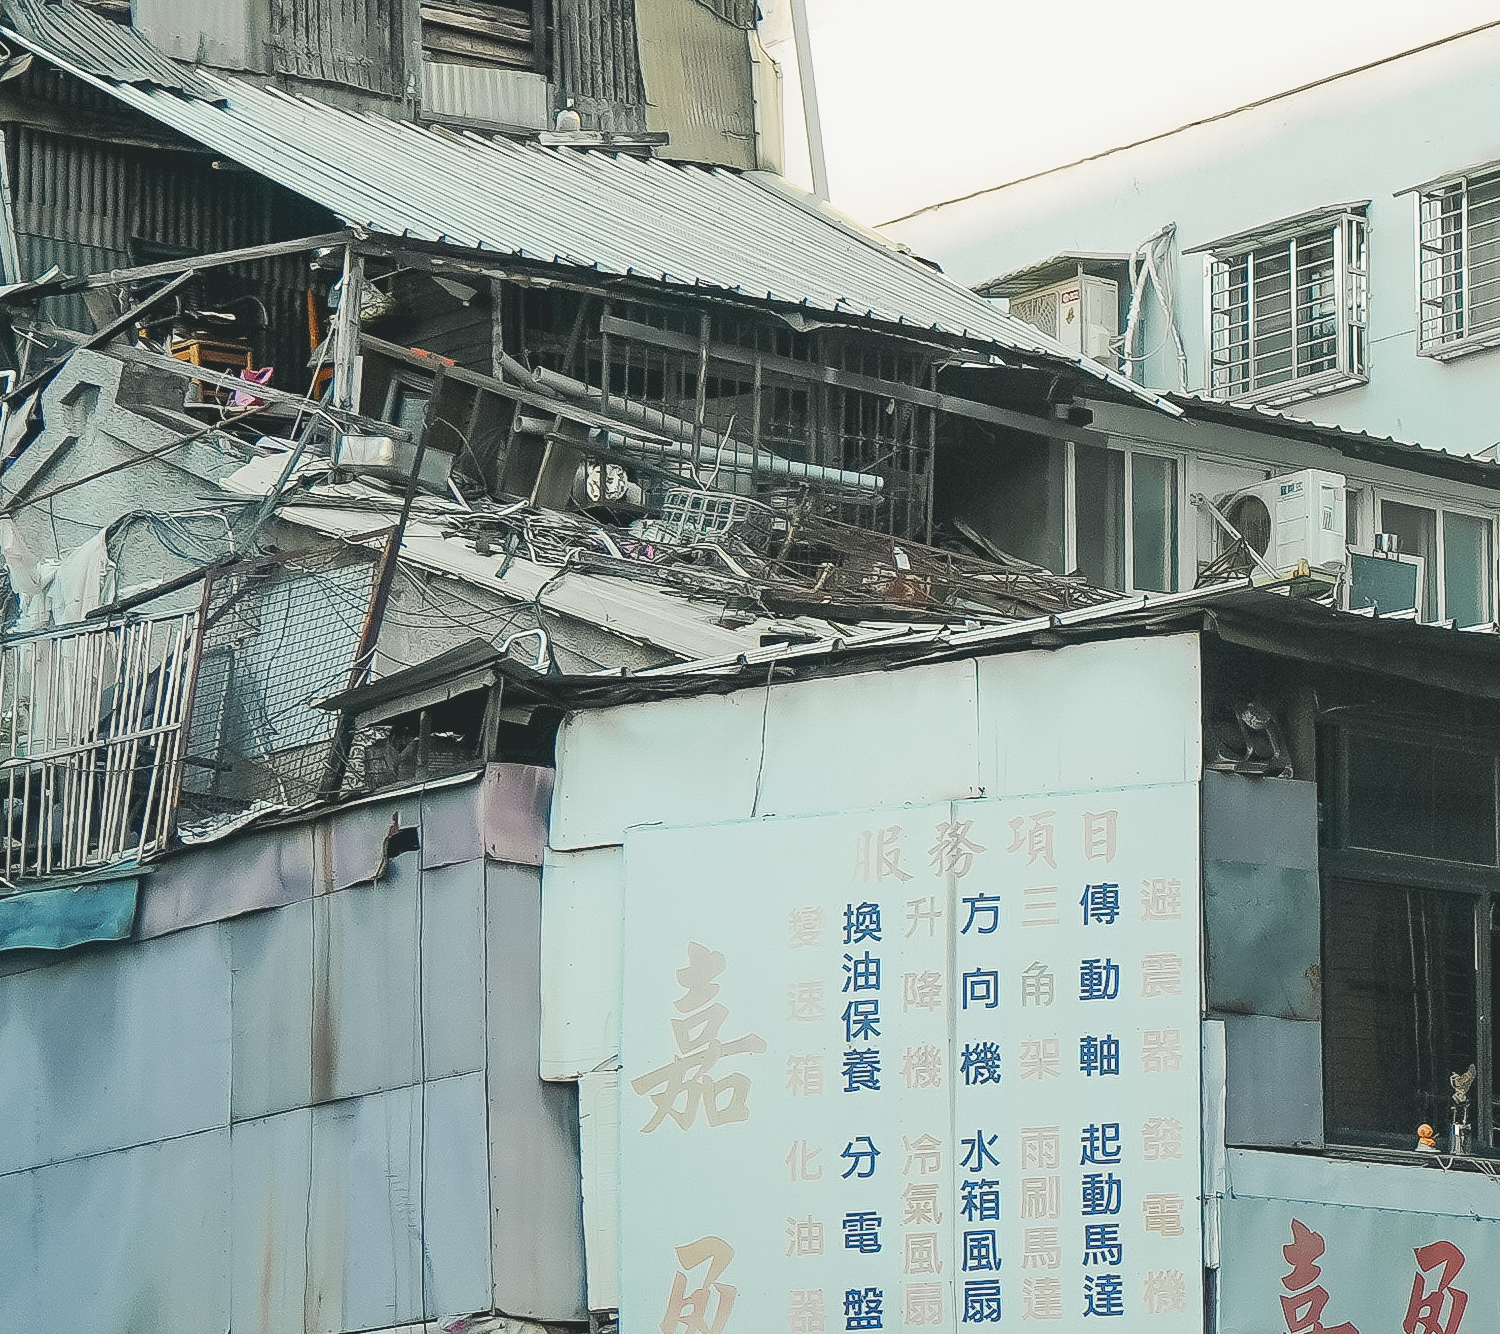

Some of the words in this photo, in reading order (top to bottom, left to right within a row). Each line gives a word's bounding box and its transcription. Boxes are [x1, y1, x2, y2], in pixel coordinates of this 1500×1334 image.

[855, 810, 1121, 883] 服務項目
[786, 907, 827, 1097] 變速箱
[841, 902, 883, 1094] 換油保養
[902, 896, 944, 1090] 升降機
[960, 892, 1003, 1085] 方向機
[1020, 886, 1061, 1080] 三角架
[1079, 883, 1121, 1078] 傳動軸
[1139, 878, 1182, 1072] 避震器
[786, 1139, 827, 1333] 化油器
[841, 1137, 885, 1332] 分電盤
[902, 1134, 944, 1327] 冷氣風扇
[959, 1131, 1003, 1323] 水箱風扇
[1020, 1126, 1063, 1321] 雨刷馬達
[1079, 1123, 1125, 1319] 起動馬達
[1141, 1117, 1187, 1316] 發電機
